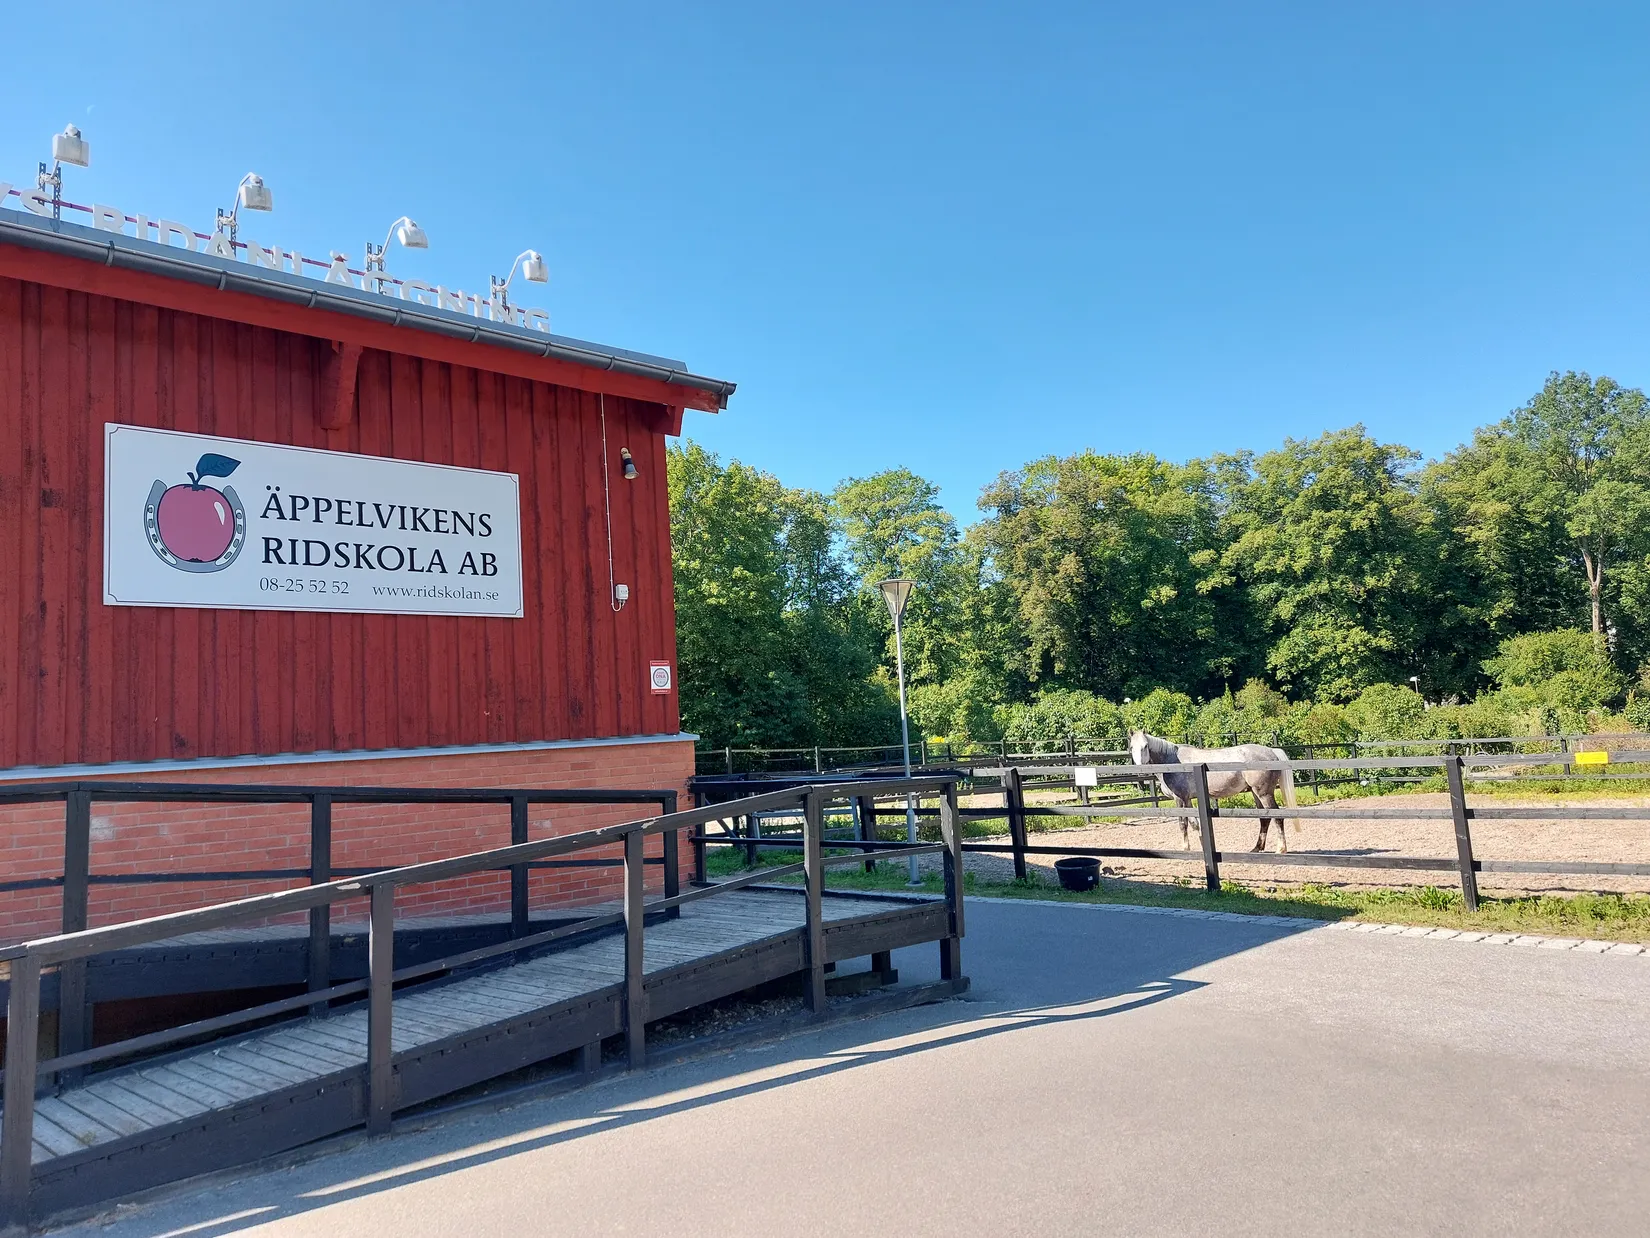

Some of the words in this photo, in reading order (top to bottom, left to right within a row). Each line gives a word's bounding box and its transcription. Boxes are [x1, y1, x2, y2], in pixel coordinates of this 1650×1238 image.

[259, 485, 493, 537] ÄPPELVIKENS
[261, 536, 449, 575] RIDSKOLA
[457, 551, 498, 577] AB
[259, 577, 304, 593] 08-25
[308, 579, 327, 593] 52
[331, 580, 350, 595] 52
[372, 585, 499, 601] www.ridskolan.se
